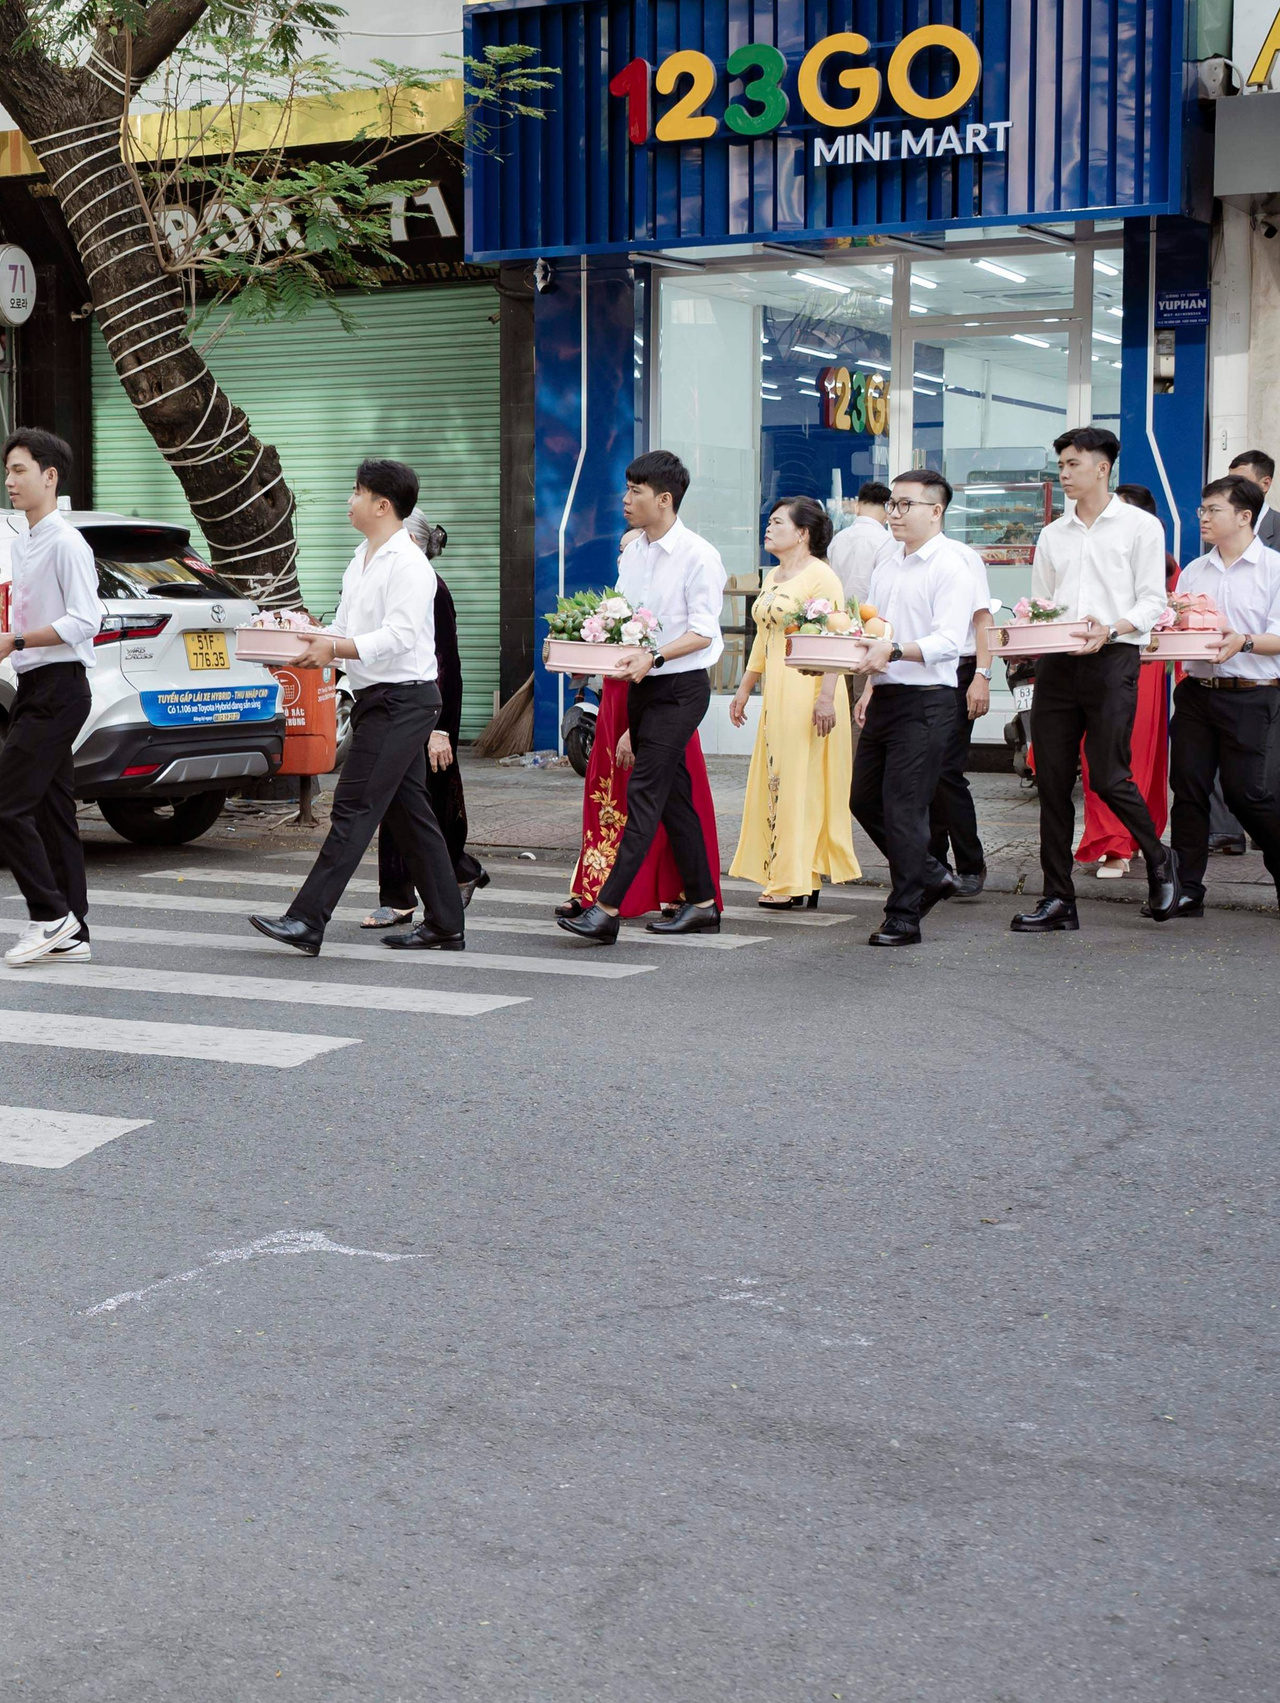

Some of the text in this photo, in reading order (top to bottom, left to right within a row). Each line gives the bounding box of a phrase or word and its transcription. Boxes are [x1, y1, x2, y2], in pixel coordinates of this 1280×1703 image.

[608, 23, 983, 147] 123GO
[813, 120, 1013, 168] MINI MART
[8, 264, 26, 293] 71
[9, 297, 28, 310] 오로라
[1158, 299, 1207, 310] YUPHAN
[196, 634, 214, 650] 51F
[193, 652, 226, 667] 776.35
[167, 704, 176, 714] Có
[176, 704, 191, 713] 1.106
[198, 703, 215, 714] Toyota
[215, 702, 231, 714] Hybrid
